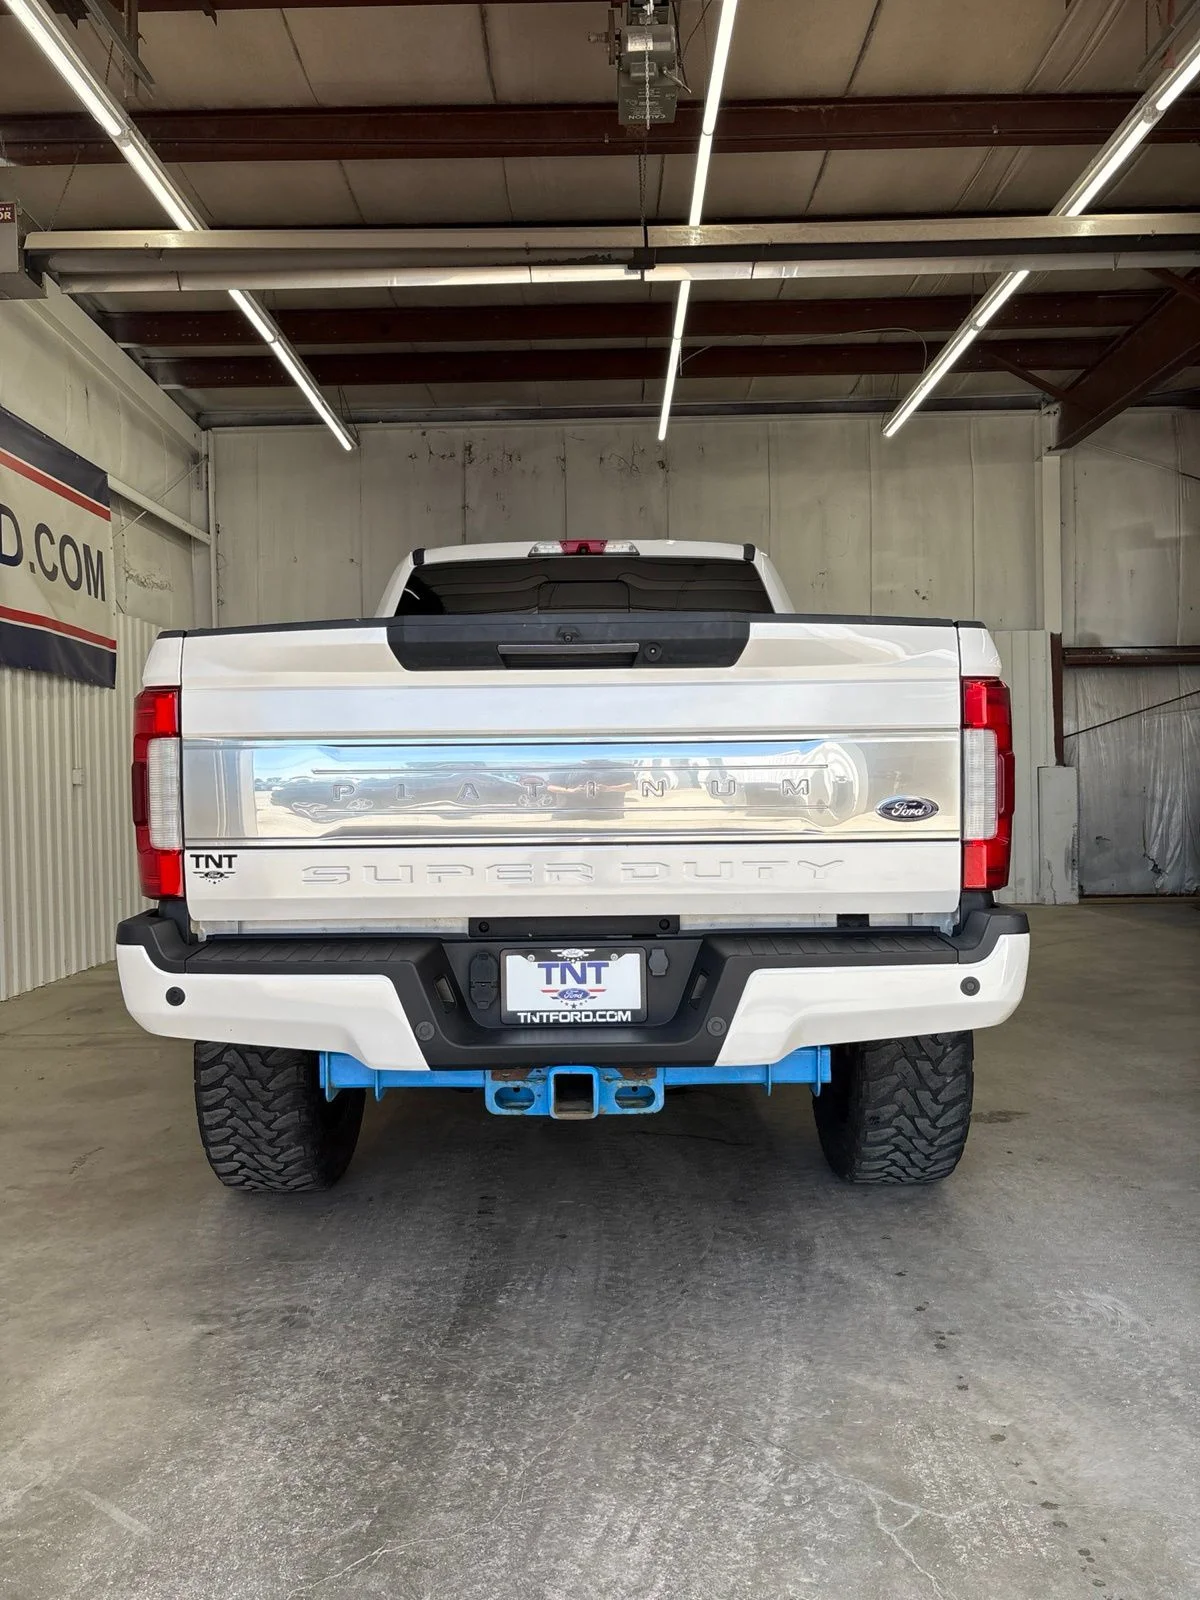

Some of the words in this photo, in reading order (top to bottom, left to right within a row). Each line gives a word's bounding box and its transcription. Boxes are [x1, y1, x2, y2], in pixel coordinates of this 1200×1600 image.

[333, 778, 810, 801] PLATINUM
[891, 801, 925, 816] Ford
[190, 854, 238, 868] TNT
[302, 862, 594, 885] SUPER
[620, 860, 844, 882] DUTY
[537, 962, 609, 985] TNT
[563, 990, 583, 999] Ford
[517, 1010, 632, 1023] TNTFORD.COM
